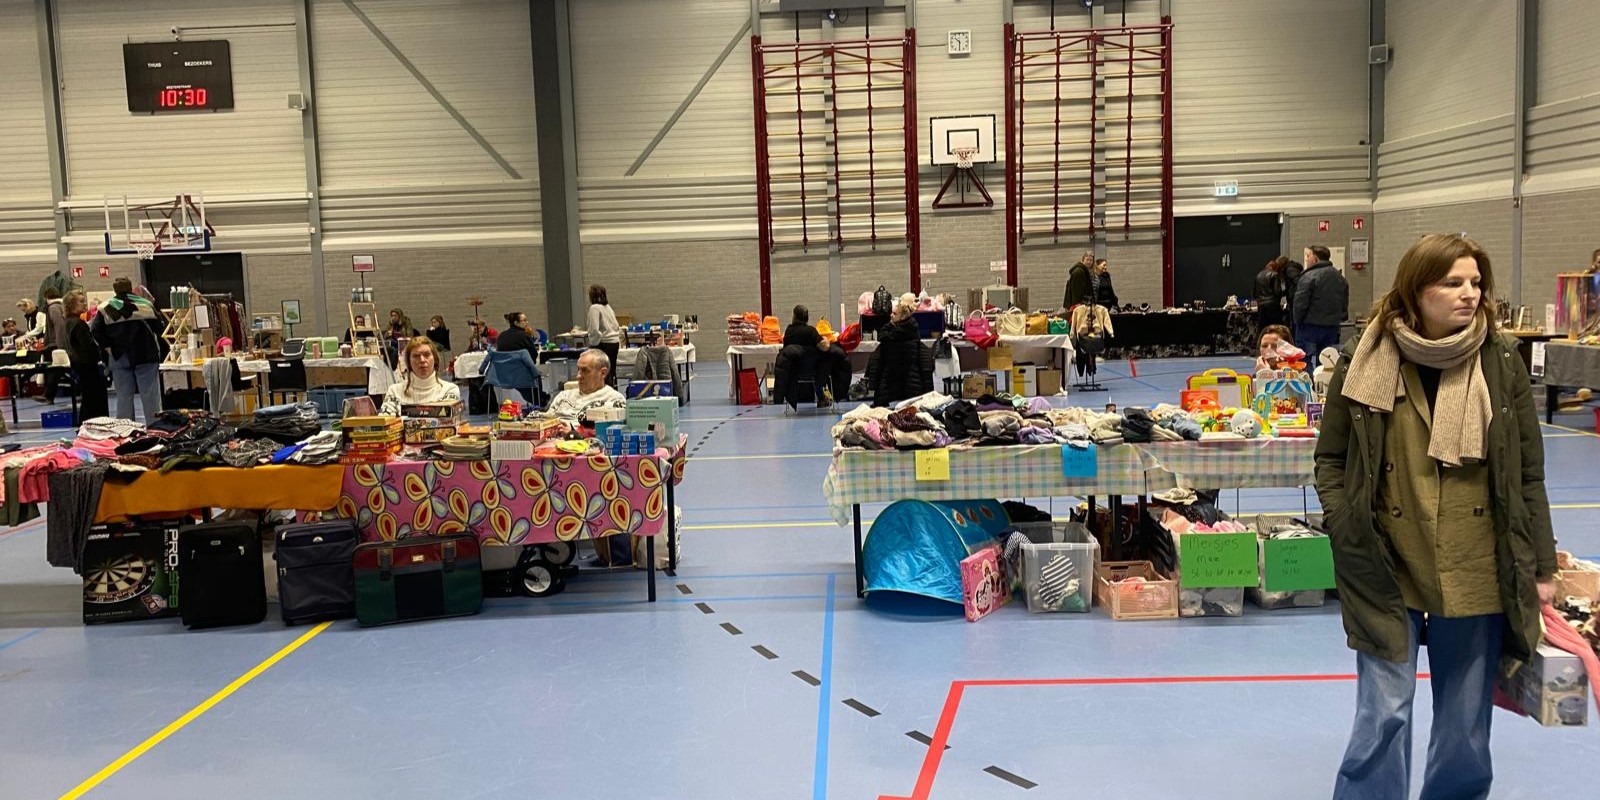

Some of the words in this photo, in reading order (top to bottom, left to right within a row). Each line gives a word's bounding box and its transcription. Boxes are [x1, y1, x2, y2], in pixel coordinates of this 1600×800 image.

[161, 89, 206, 107] 10:30
[1189, 536, 1239, 552] Meisjes
[164, 548, 169, 557] TO
